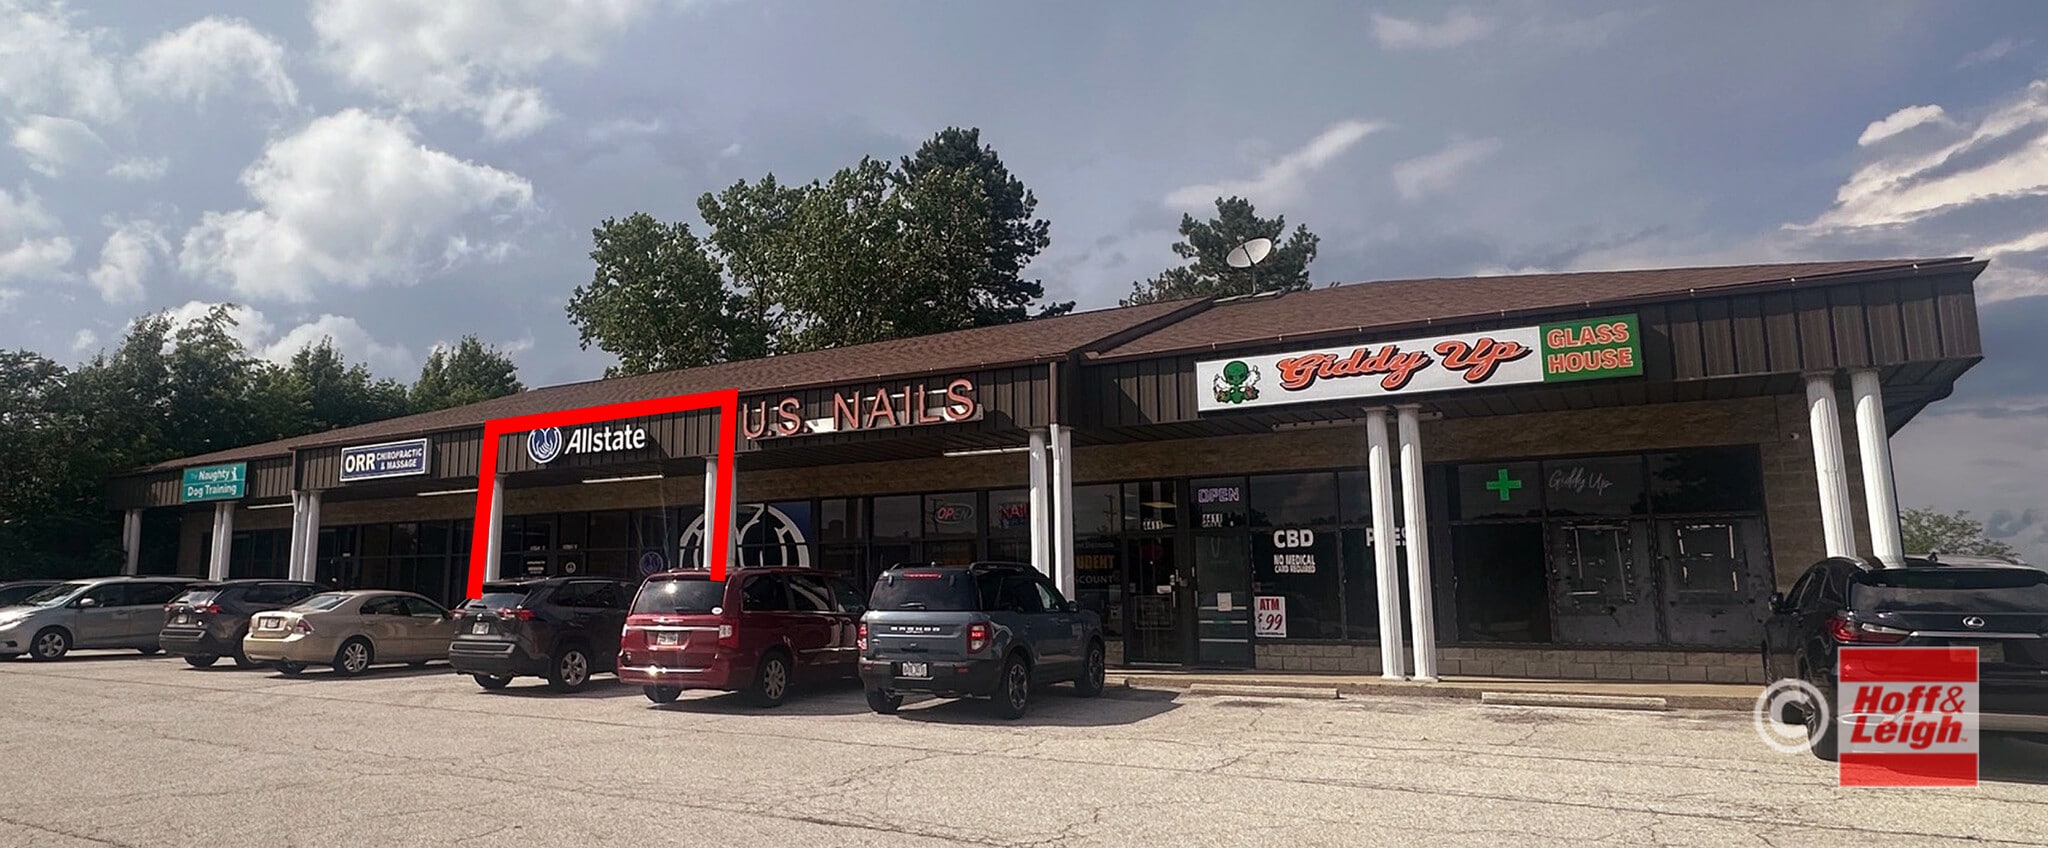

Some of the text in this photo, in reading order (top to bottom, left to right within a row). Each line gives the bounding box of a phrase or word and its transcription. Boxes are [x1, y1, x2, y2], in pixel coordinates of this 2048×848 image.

[1547, 322, 1629, 349] GLASS
[1275, 337, 1533, 391] Giddy Up
[1547, 347, 1634, 374] HOUSE
[742, 378, 975, 439] U.S. NAILS
[564, 424, 645, 455] Allstate
[376, 447, 423, 461] CHIROPRACTIC
[345, 452, 376, 473] ORR
[386, 458, 417, 470] MASSAGE
[199, 470, 230, 481] Naughty
[187, 483, 237, 498] Dog Training
[1198, 487, 1239, 503] OPEN
[937, 506, 971, 520] OPEN
[1273, 529, 1314, 548] CBD
[1273, 554, 1316, 566] NO MEDICAL
[1259, 598, 1280, 611] ATM
